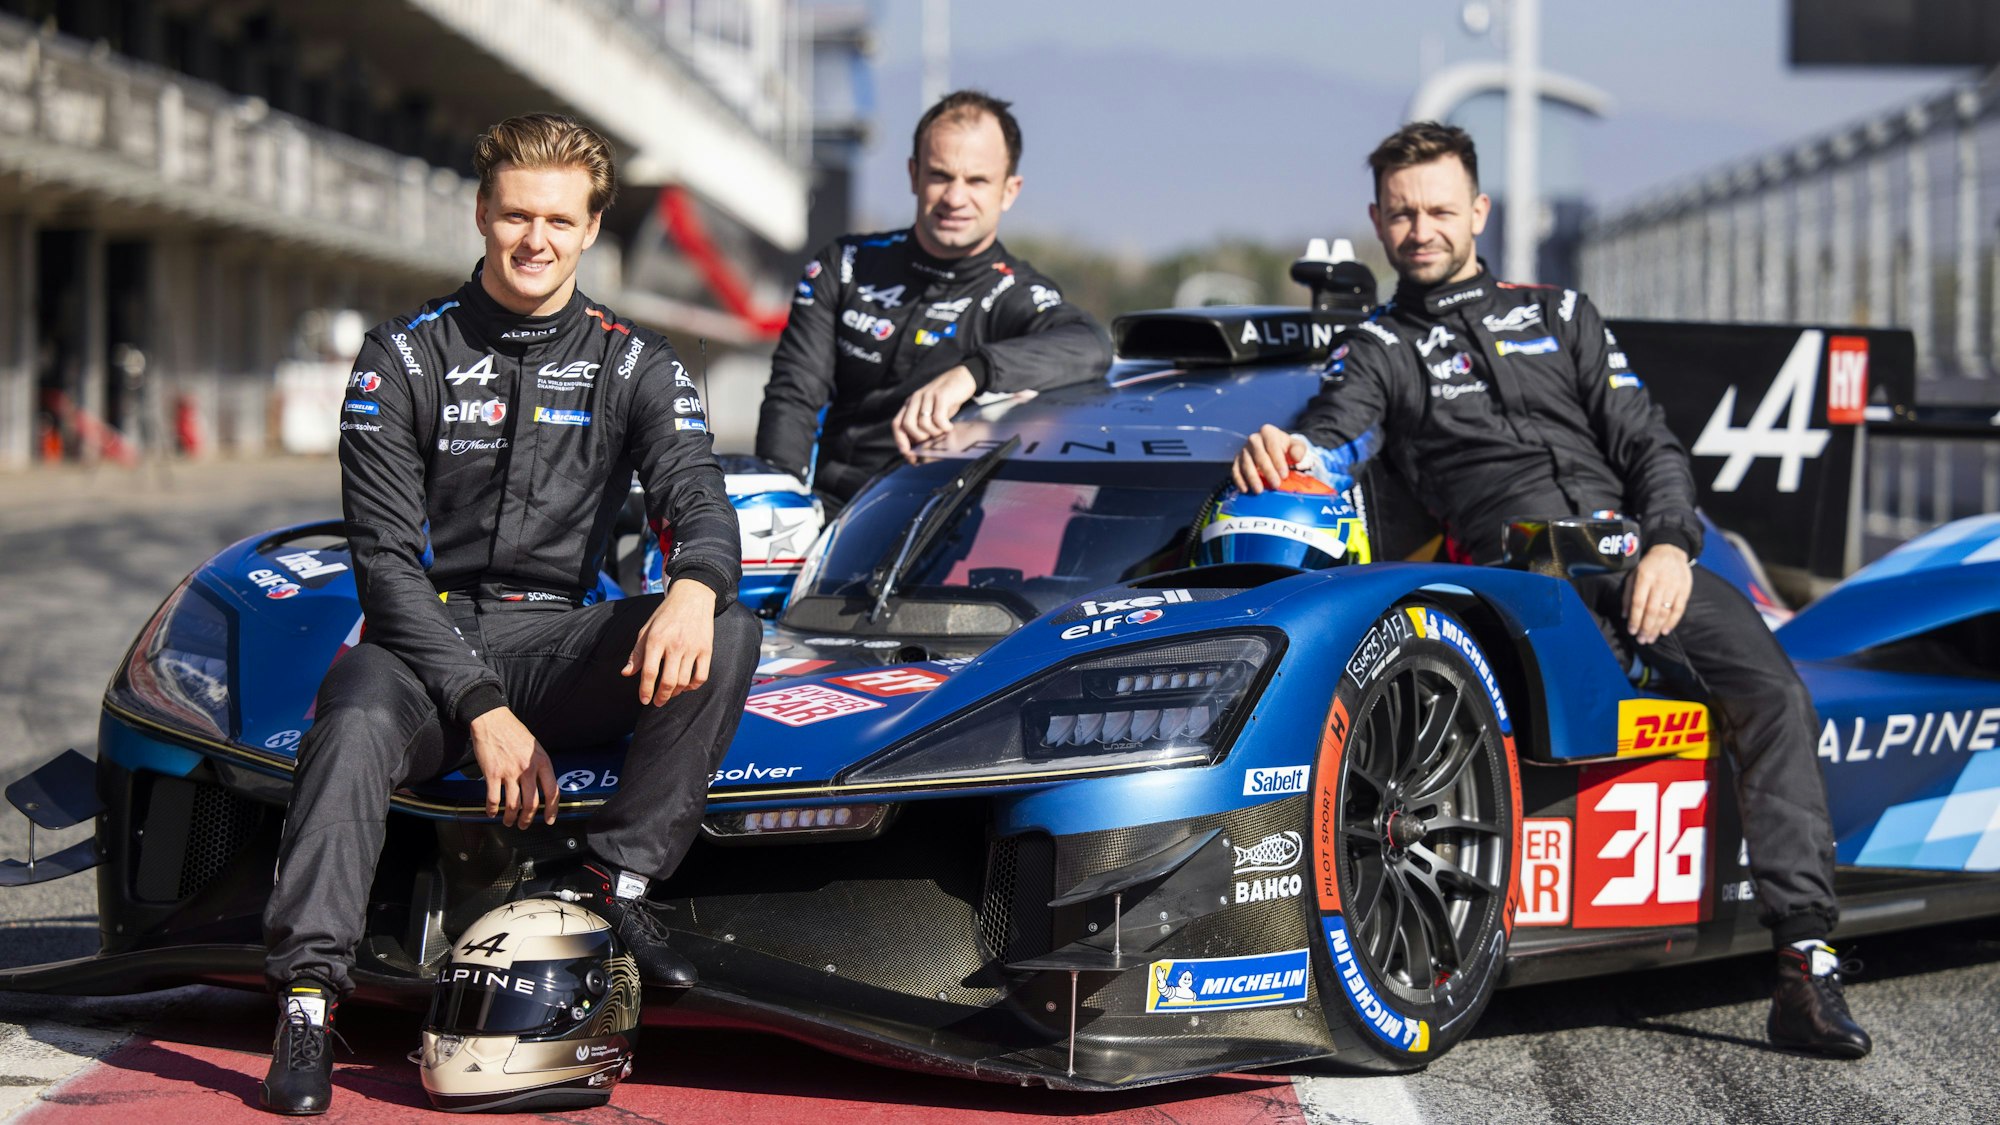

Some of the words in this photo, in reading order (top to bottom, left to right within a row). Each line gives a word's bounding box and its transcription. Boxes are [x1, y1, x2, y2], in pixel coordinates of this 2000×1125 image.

[501, 327, 557, 339] ALPINE
[1241, 319, 1346, 349] ALPIN
[391, 333, 421, 376] Sabelt
[617, 336, 645, 380] Sabelt
[538, 361, 601, 379] WEC
[1829, 350, 1869, 411] HY
[443, 401, 482, 424] elf
[552, 414, 591, 424] MICHELIN
[923, 434, 1192, 456] LPINE
[1222, 520, 1315, 542] ALPINE
[1598, 535, 1624, 555] elf
[247, 568, 289, 588] elf
[1080, 589, 1193, 617] ixell
[1061, 615, 1123, 640] elf
[842, 669, 942, 692] HY
[1442, 619, 1508, 721] MICHELIN
[746, 693, 838, 723] CAR
[783, 686, 870, 711] HYPER
[1331, 712, 1346, 745] H
[1633, 710, 1706, 750] DHL
[1818, 707, 2000, 764] ALPINE
[1251, 770, 1303, 793] Sabelt
[1322, 786, 1332, 846] SPORT
[1590, 780, 1710, 906] 36
[1234, 874, 1303, 904] BAHCO
[1322, 853, 1334, 897] PILOT
[1200, 968, 1306, 995] MICHELIN
[1329, 929, 1403, 1039] MICHELIN
